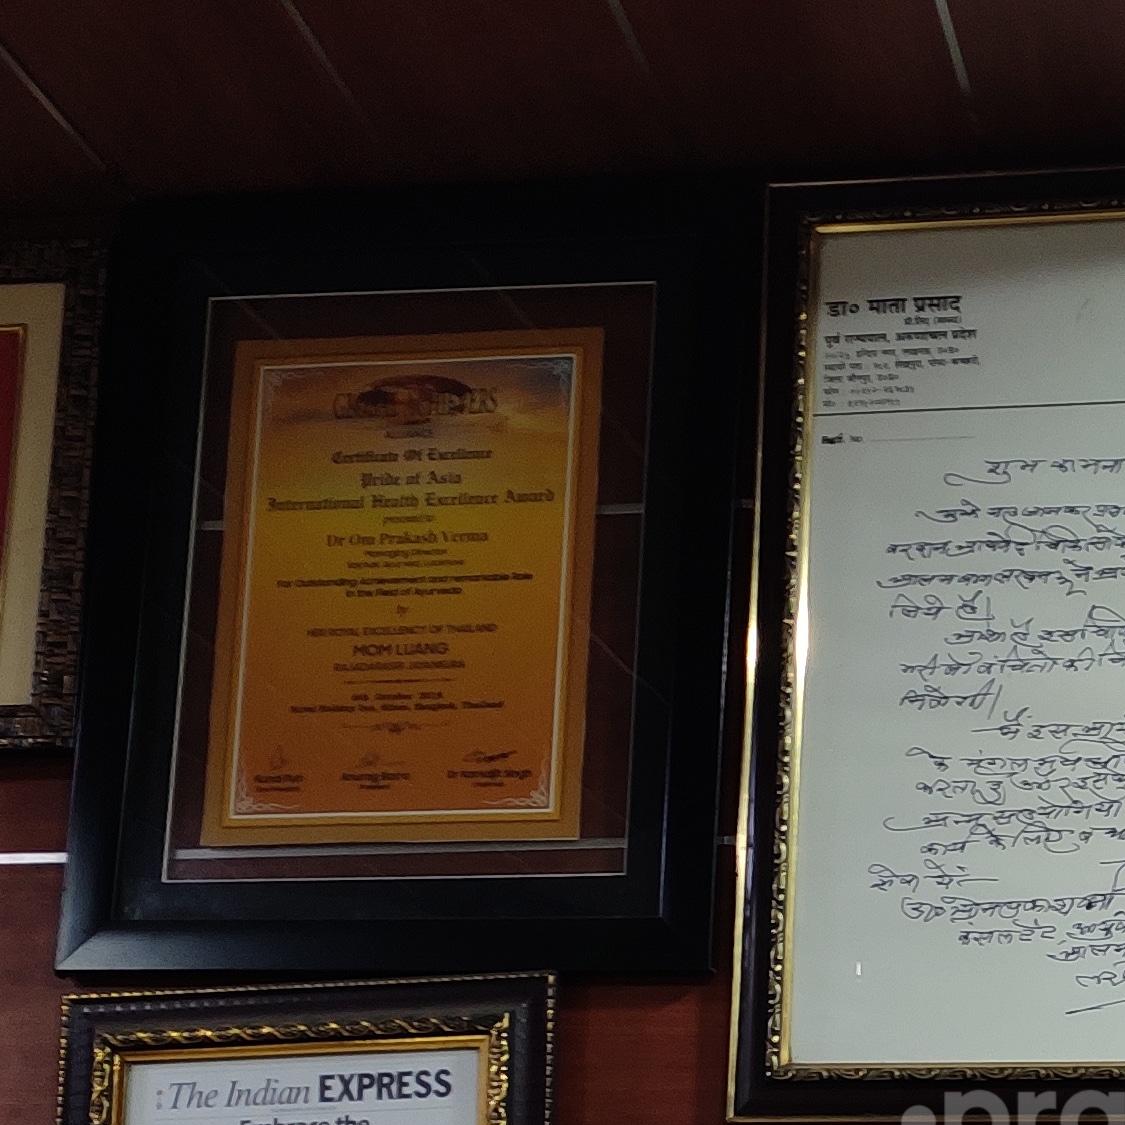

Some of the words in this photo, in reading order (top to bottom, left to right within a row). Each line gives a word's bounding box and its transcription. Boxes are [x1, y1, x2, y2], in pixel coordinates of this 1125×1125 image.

[867, 298, 908, 315] माता
[912, 295, 963, 313] प्रसाद
[332, 450, 398, 464] Certificate
[427, 447, 493, 461] Excellence
[426, 469, 462, 485] Asia
[505, 488, 555, 504] Award
[168, 1080, 219, 1110] The
[224, 1078, 310, 1109] Indian
[319, 1069, 453, 1103] EXPRESS
